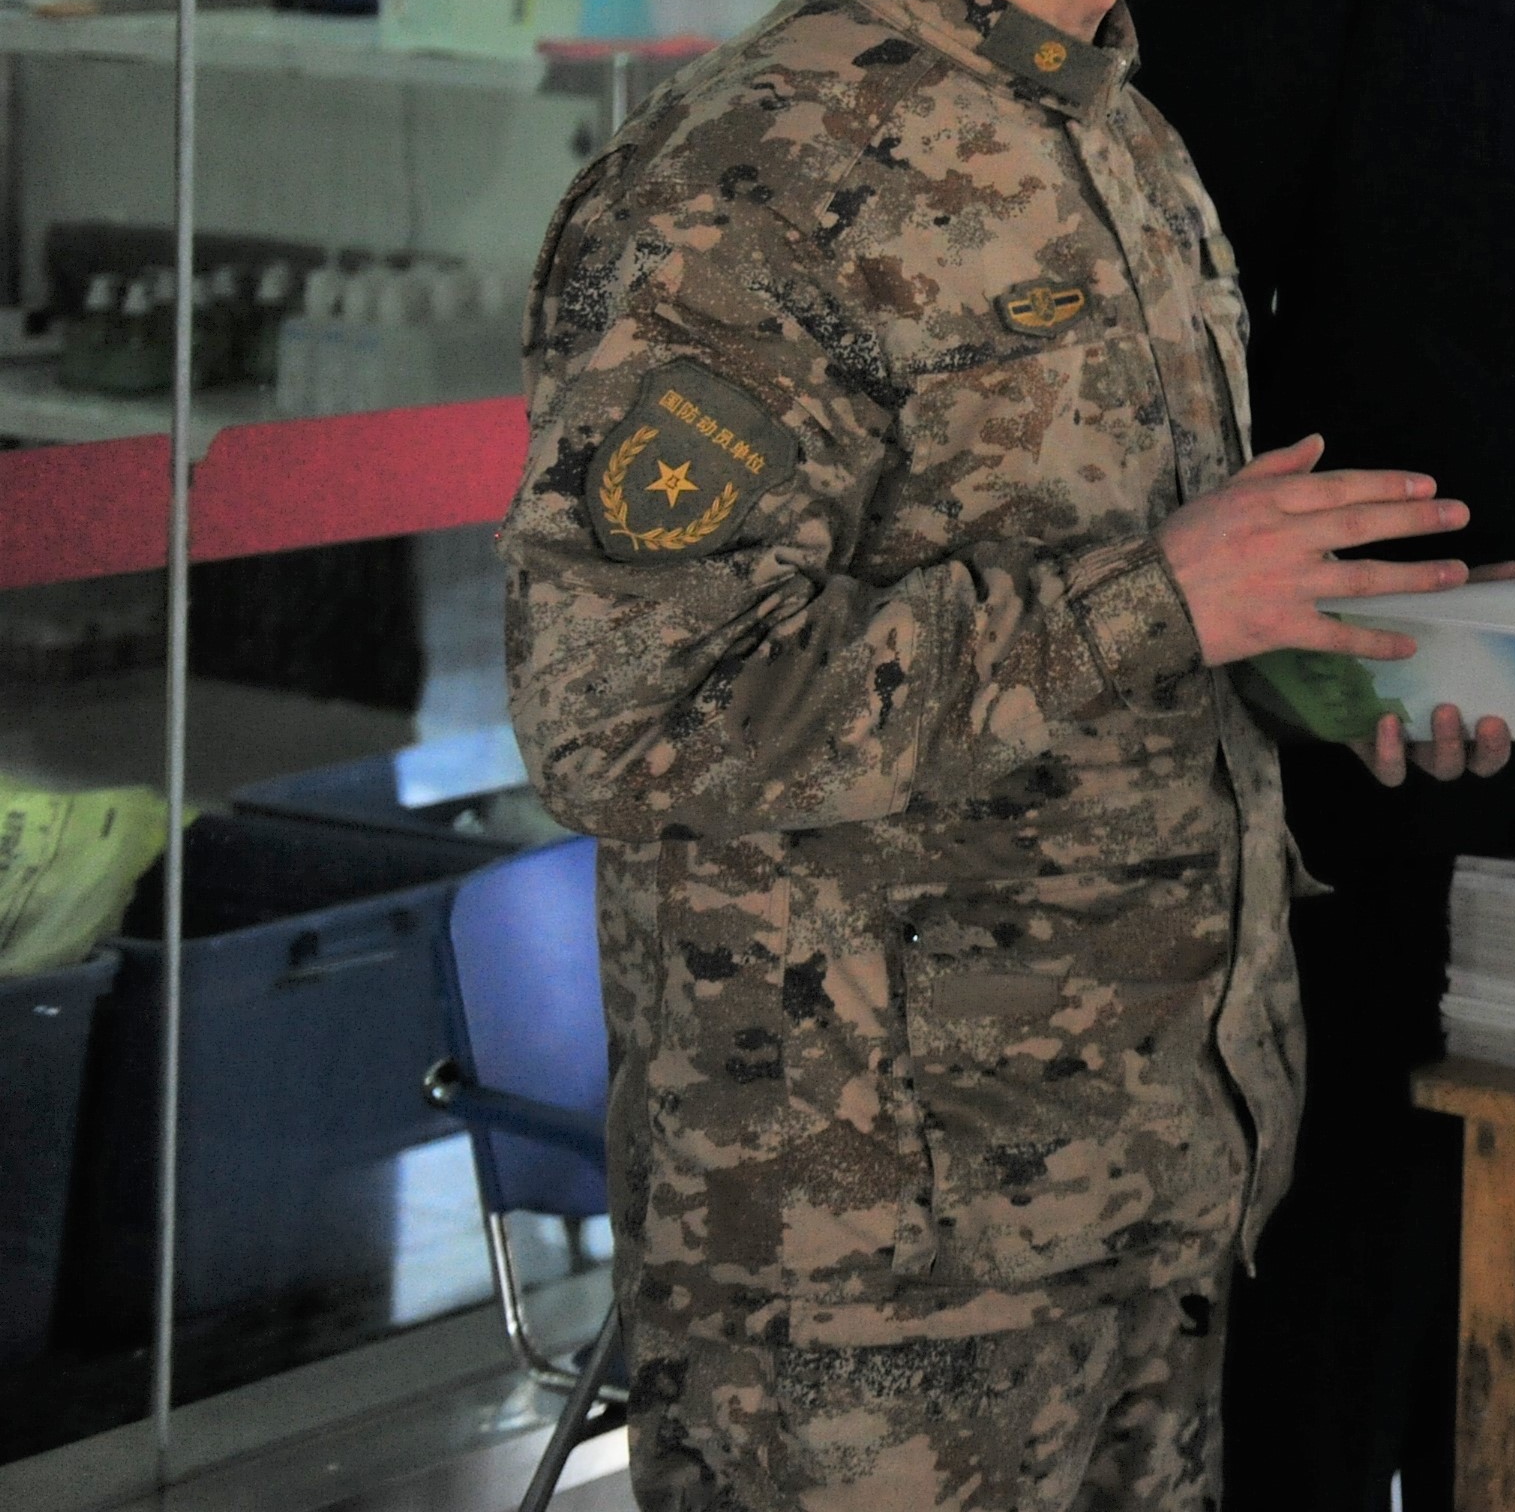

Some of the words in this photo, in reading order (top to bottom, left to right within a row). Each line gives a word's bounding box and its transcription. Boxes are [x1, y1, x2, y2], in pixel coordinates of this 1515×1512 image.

[659, 389, 766, 475] 国防动员单位
